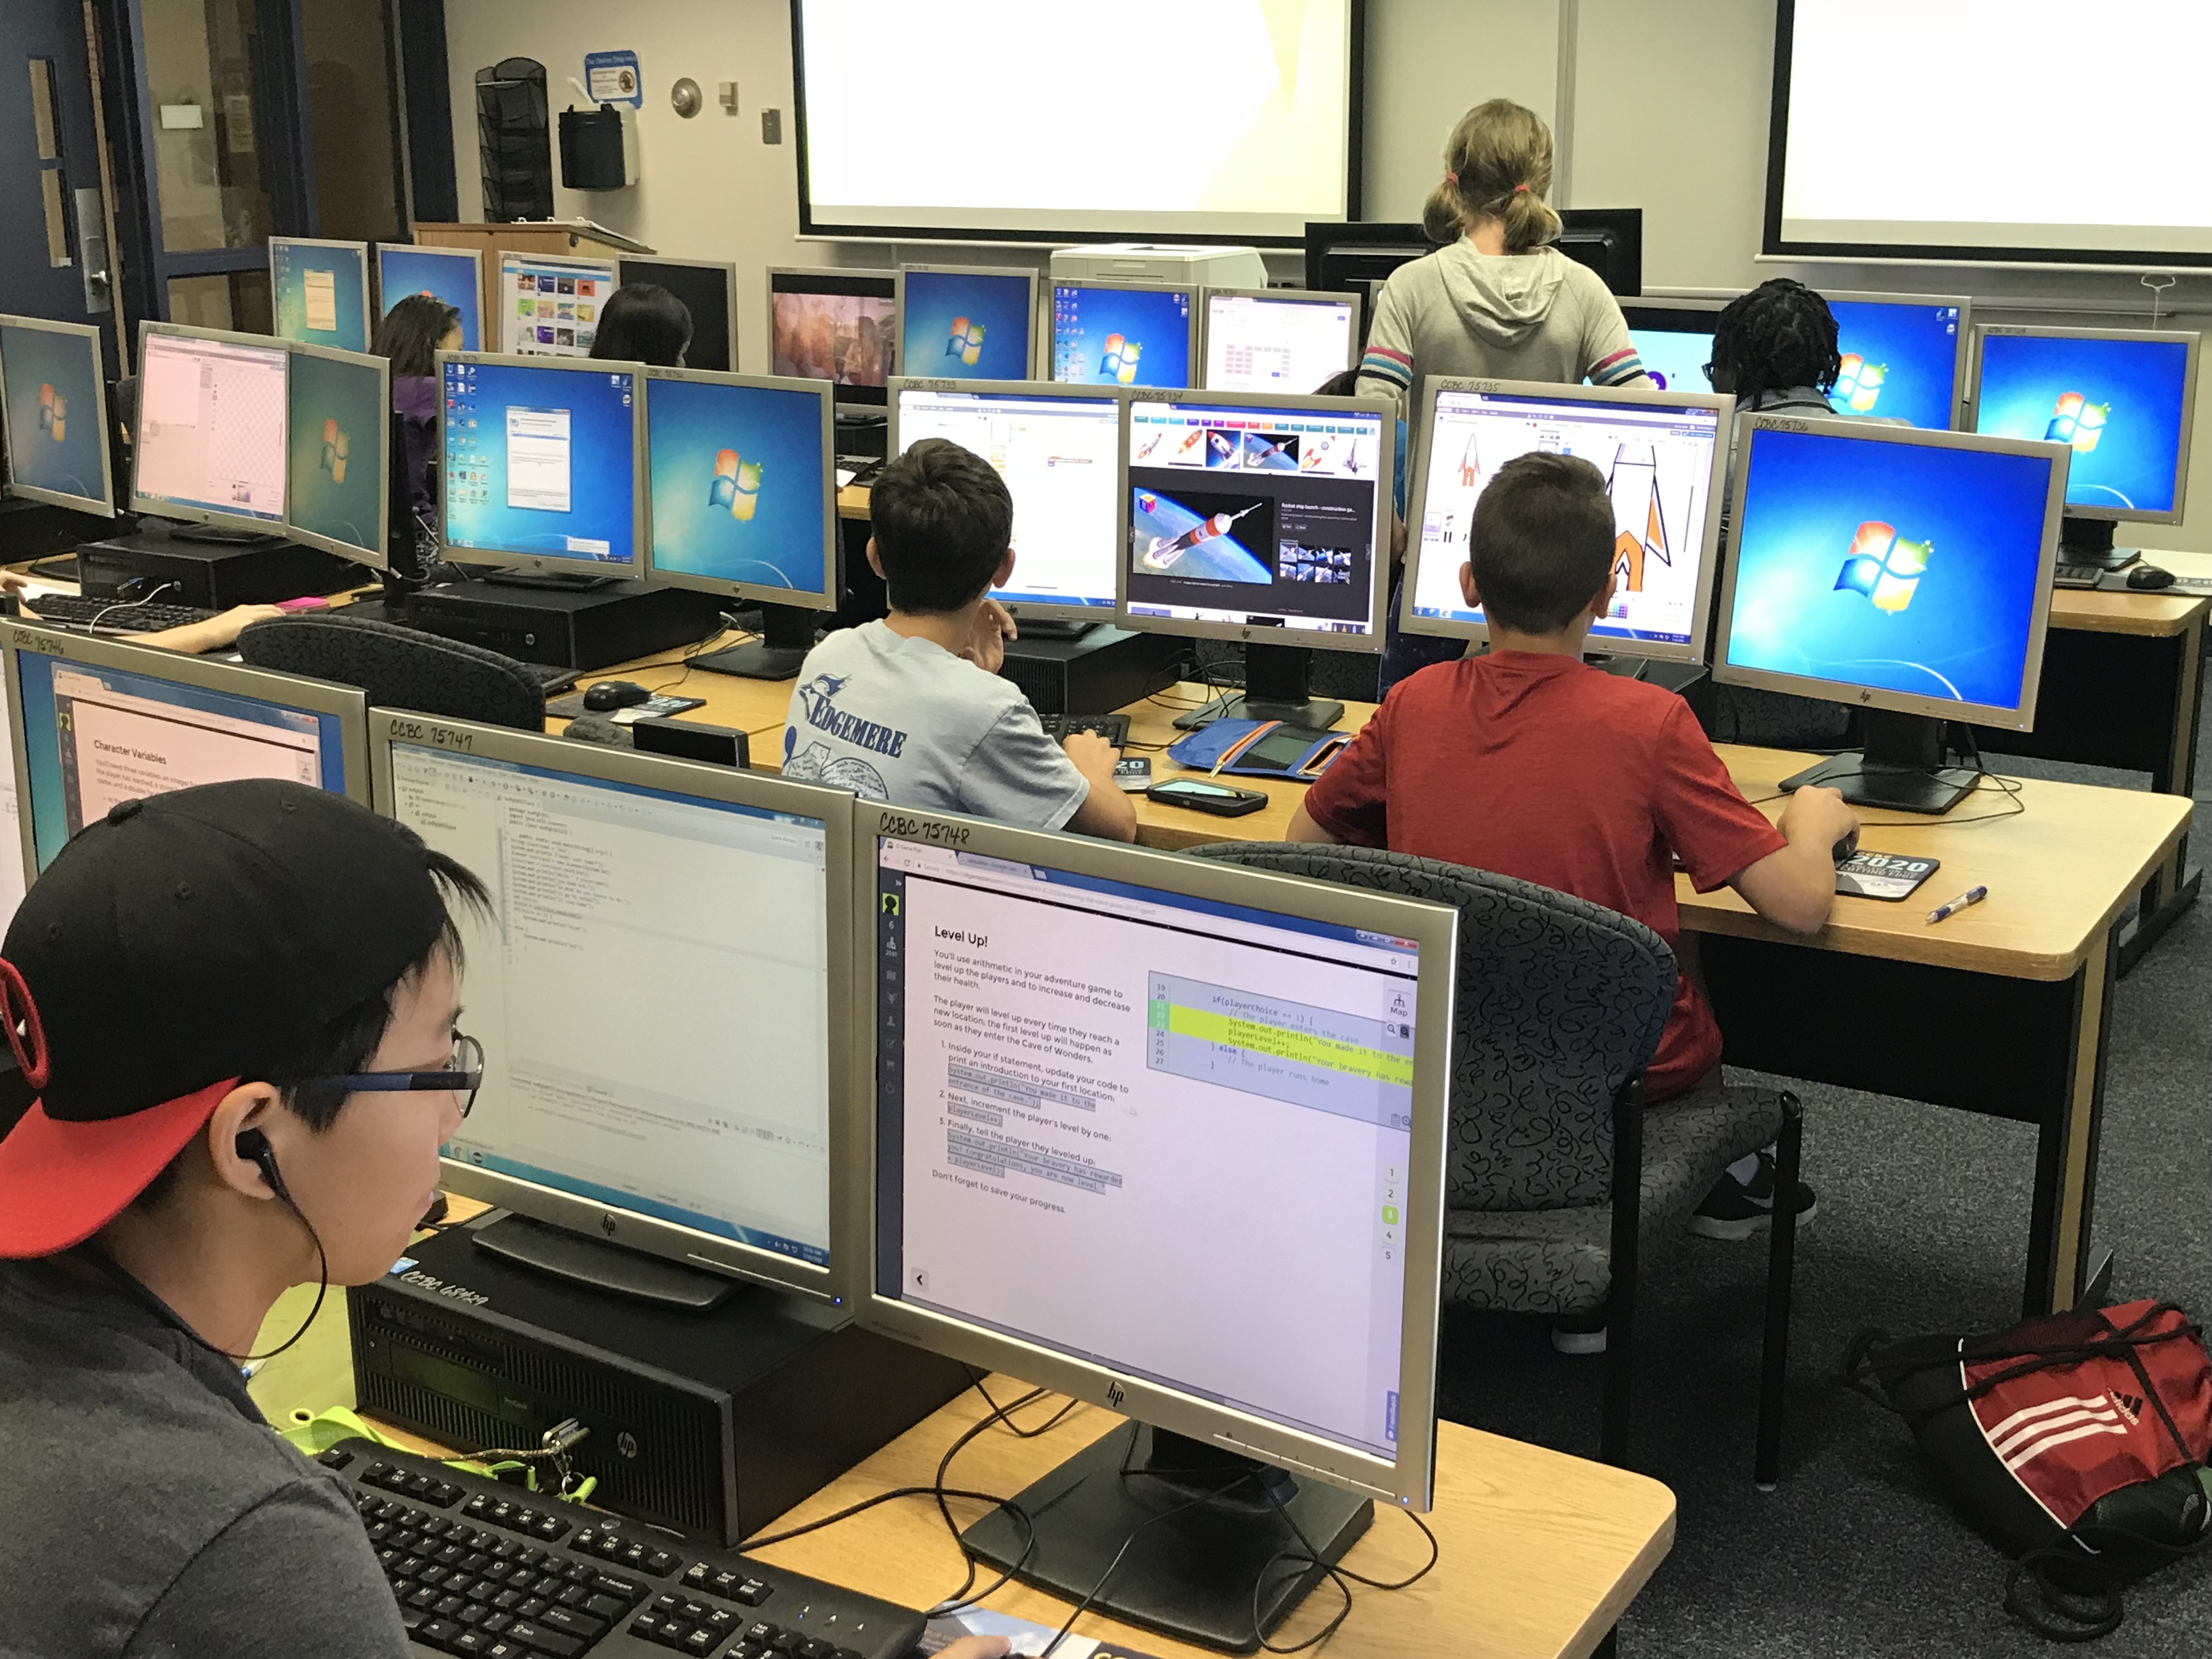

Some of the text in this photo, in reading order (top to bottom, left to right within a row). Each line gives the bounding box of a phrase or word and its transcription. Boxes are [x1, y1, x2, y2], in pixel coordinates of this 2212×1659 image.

[928, 380, 956, 390] 75733
[1441, 379, 1500, 392] CCBC 75735
[1860, 689, 1871, 703] hp
[390, 720, 473, 751] CCBC 75747
[94, 740, 167, 765] Character Variables
[879, 812, 970, 844] CCBC 75748
[1847, 855, 1928, 872] 2020
[889, 921, 895, 929] 6
[935, 925, 988, 948] Level Up!
[934, 949, 1122, 998] You'll use arithmetic in your adventure game to
[934, 972, 951, 983] their
[934, 960, 1130, 1012] level up the players and to increase and decrease
[933, 994, 948, 1005] The
[950, 1000, 974, 1011] player
[975, 1006, 989, 1014] will
[991, 1008, 1009, 1019] level
[1011, 1014, 1022, 1023] up
[1023, 1017, 1046, 1030] every
[1048, 1022, 1066, 1033] time
[1069, 1026, 1087, 1039] they
[1089, 1032, 1112, 1043] reach
[1390, 1006, 1408, 1017] Map
[933, 1019, 952, 1029] soon
[964, 1025, 982, 1037] they
[983, 1031, 1005, 1041] enter
[1007, 1035, 1020, 1045] the
[1022, 1039, 1042, 1051] Cave
[1043, 1045, 1052, 1053] of
[934, 1008, 950, 1017] new
[987, 1019, 1001, 1029] the
[1002, 1022, 1018, 1033] first
[1020, 1026, 1039, 1038] level
[1040, 1033, 1052, 1042] up
[1053, 1036, 1068, 1045] will
[1069, 1038, 1101, 1053] happen
[948, 1042, 972, 1054] Inside
[973, 1049, 991, 1059] your
[993, 1052, 998, 1060] if
[1045, 1067, 1074, 1080] update
[1076, 1075, 1094, 1085] your
[1097, 1080, 1118, 1091] code
[1119, 1084, 1128, 1093] to
[948, 1053, 967, 1066] print
[968, 1060, 978, 1068] an
[980, 1061, 1029, 1081] introduction
[1030, 1074, 1039, 1082] to
[1041, 1077, 1059, 1087] your
[1061, 1081, 1077, 1092] first
[970, 1098, 1011, 1115] increment
[1012, 1109, 1025, 1119] the
[1028, 1112, 1058, 1130] player's
[1060, 1120, 1079, 1132] level
[1081, 1126, 1091, 1138] by
[976, 1126, 989, 1137] tell
[991, 1131, 1003, 1141] the
[1005, 1134, 1030, 1149] player
[1031, 1141, 1049, 1155] they
[1051, 1146, 1080, 1161] leveled
[1390, 1168, 1394, 1177] 1
[932, 1169, 952, 1182] Don't
[955, 1175, 978, 1189] forget
[980, 1182, 989, 1192] to
[990, 1186, 1008, 1197] save
[1009, 1192, 1028, 1202] your
[1388, 1189, 1393, 1198] 2
[603, 1213, 616, 1237] hp
[1387, 1210, 1393, 1219] 3
[1386, 1231, 1392, 1239] 4
[1385, 1251, 1391, 1260] 5
[1107, 1381, 1125, 1408] hp
[621, 1431, 635, 1456] hp
